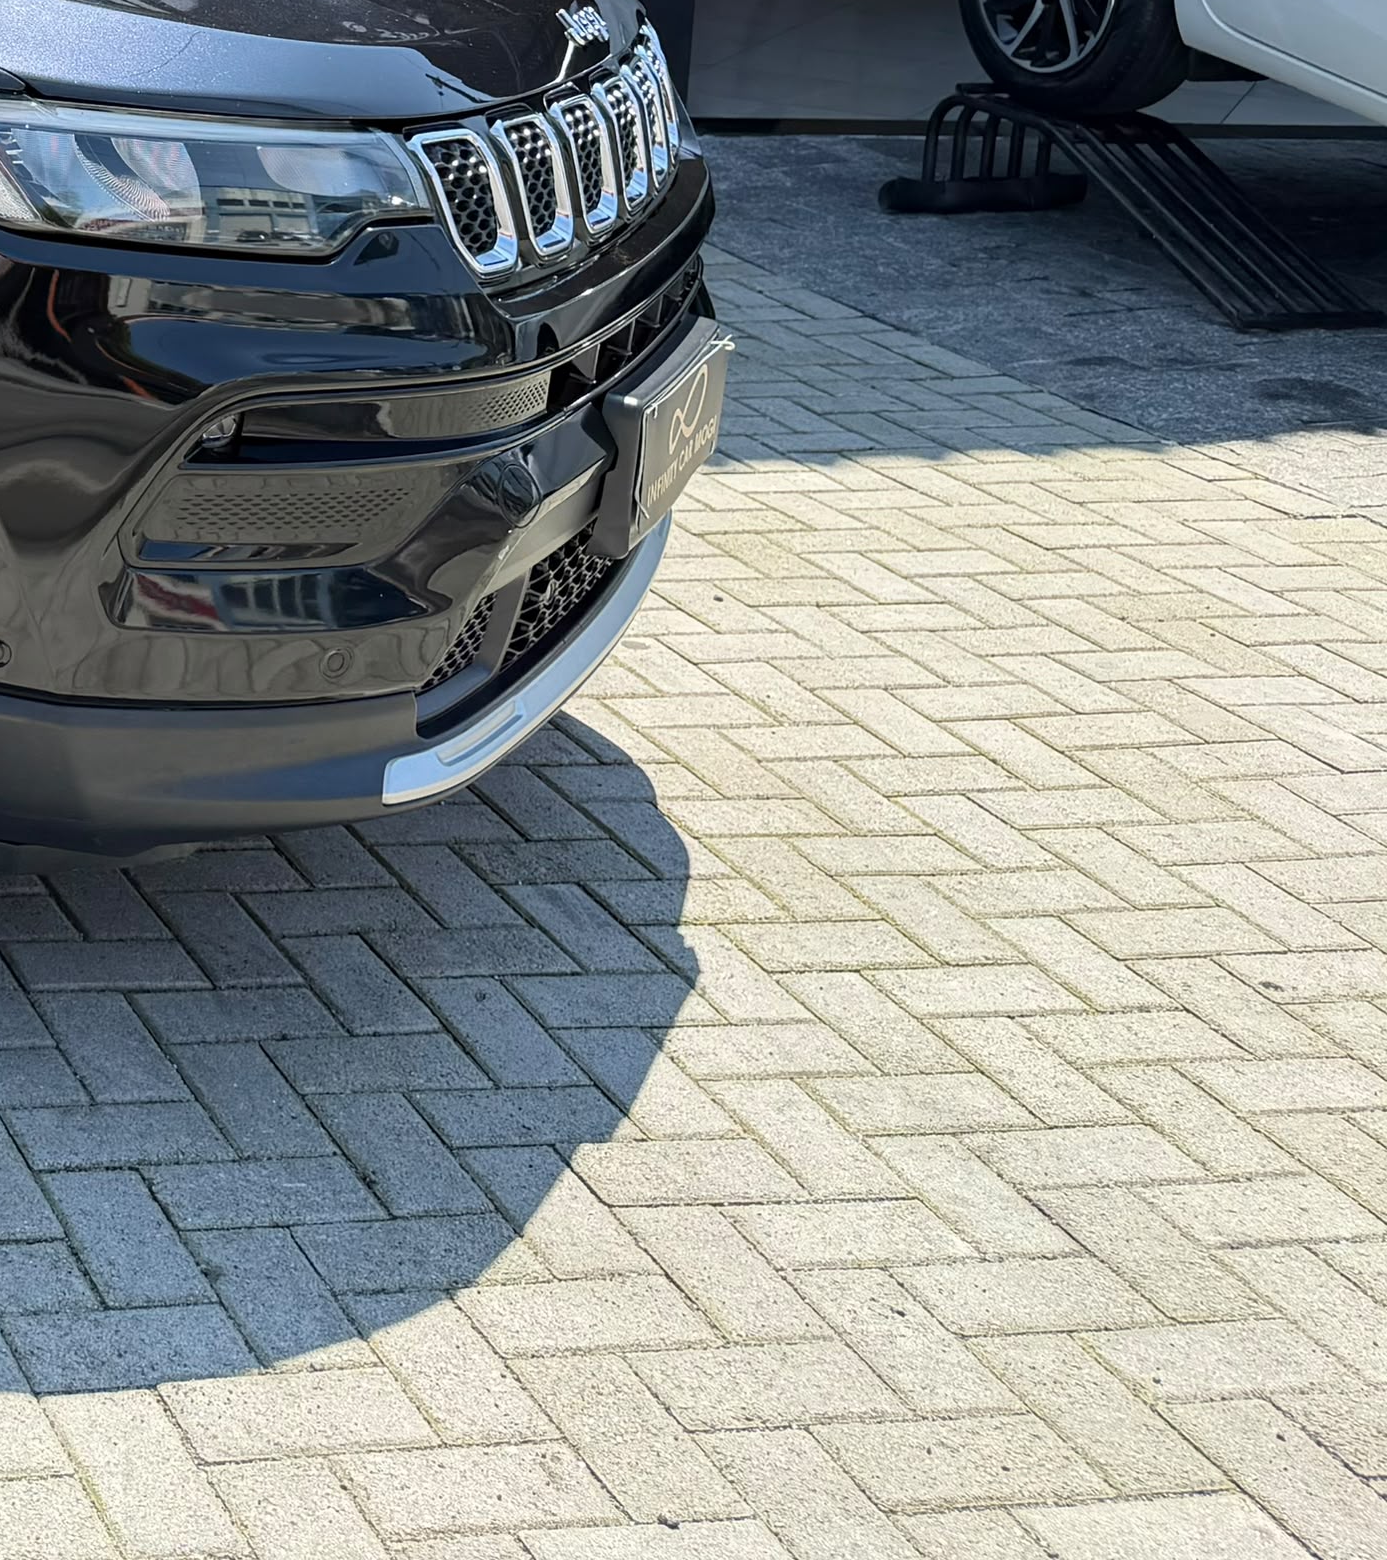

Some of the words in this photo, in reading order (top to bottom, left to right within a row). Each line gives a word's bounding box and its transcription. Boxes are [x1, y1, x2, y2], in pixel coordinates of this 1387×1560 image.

[647, 456, 679, 507] INFINITY
[678, 439, 694, 472] CAR
[694, 414, 718, 454] MOGI
